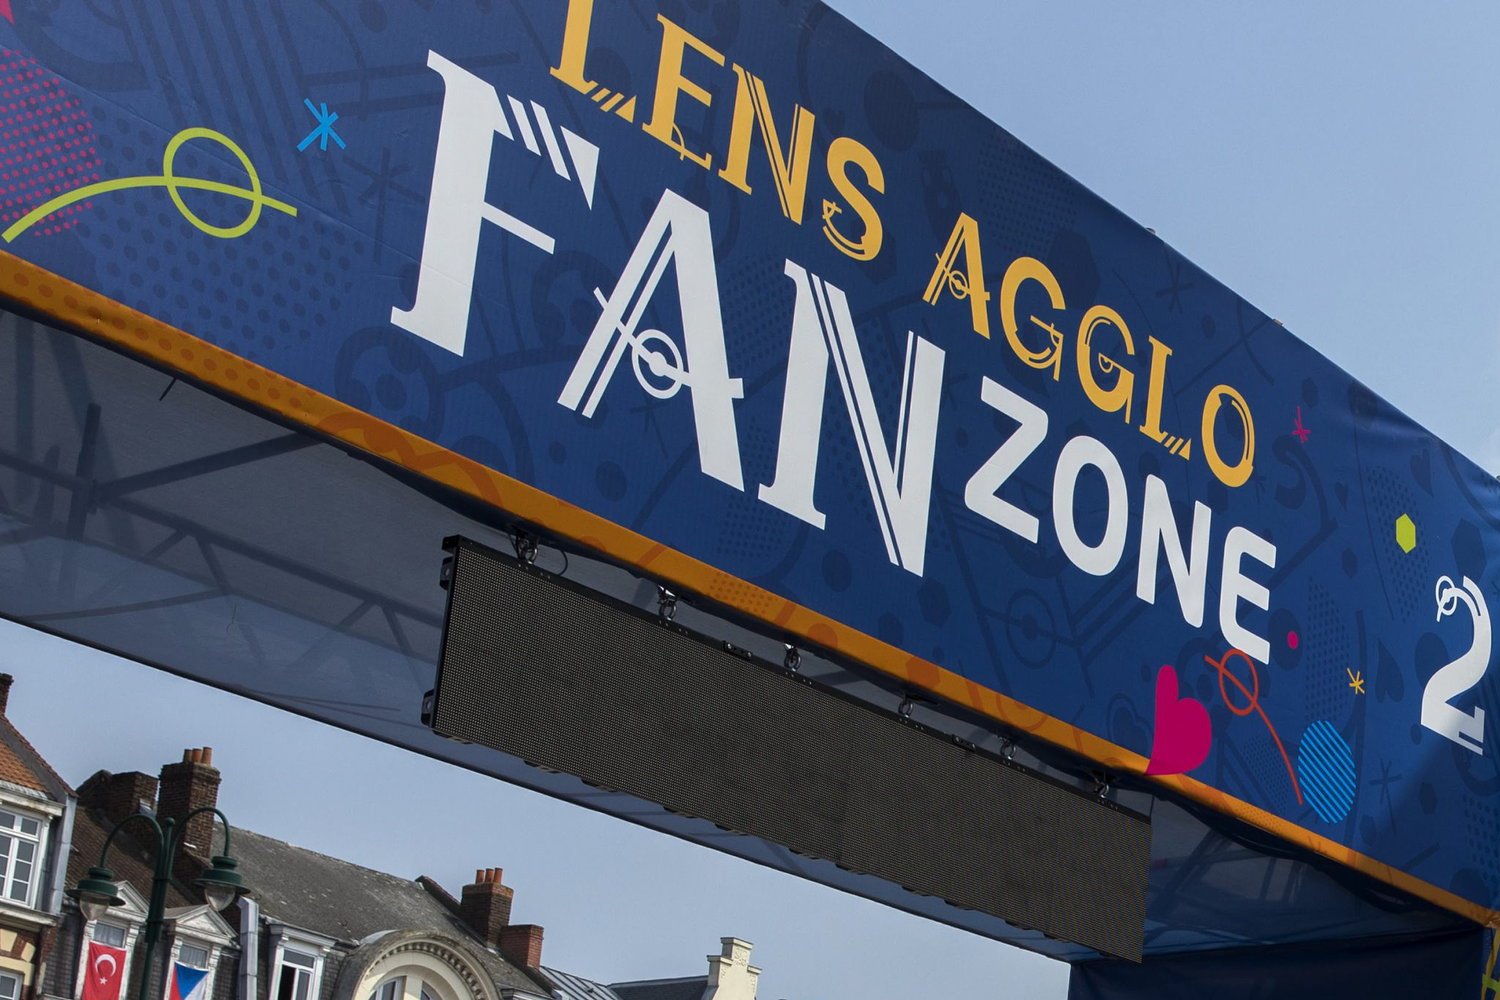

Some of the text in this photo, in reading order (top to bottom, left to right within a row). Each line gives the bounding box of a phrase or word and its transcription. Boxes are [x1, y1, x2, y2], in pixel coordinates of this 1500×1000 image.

[550, 0, 1256, 488] LENS AGGLO
[1421, 575, 1493, 756] 2
